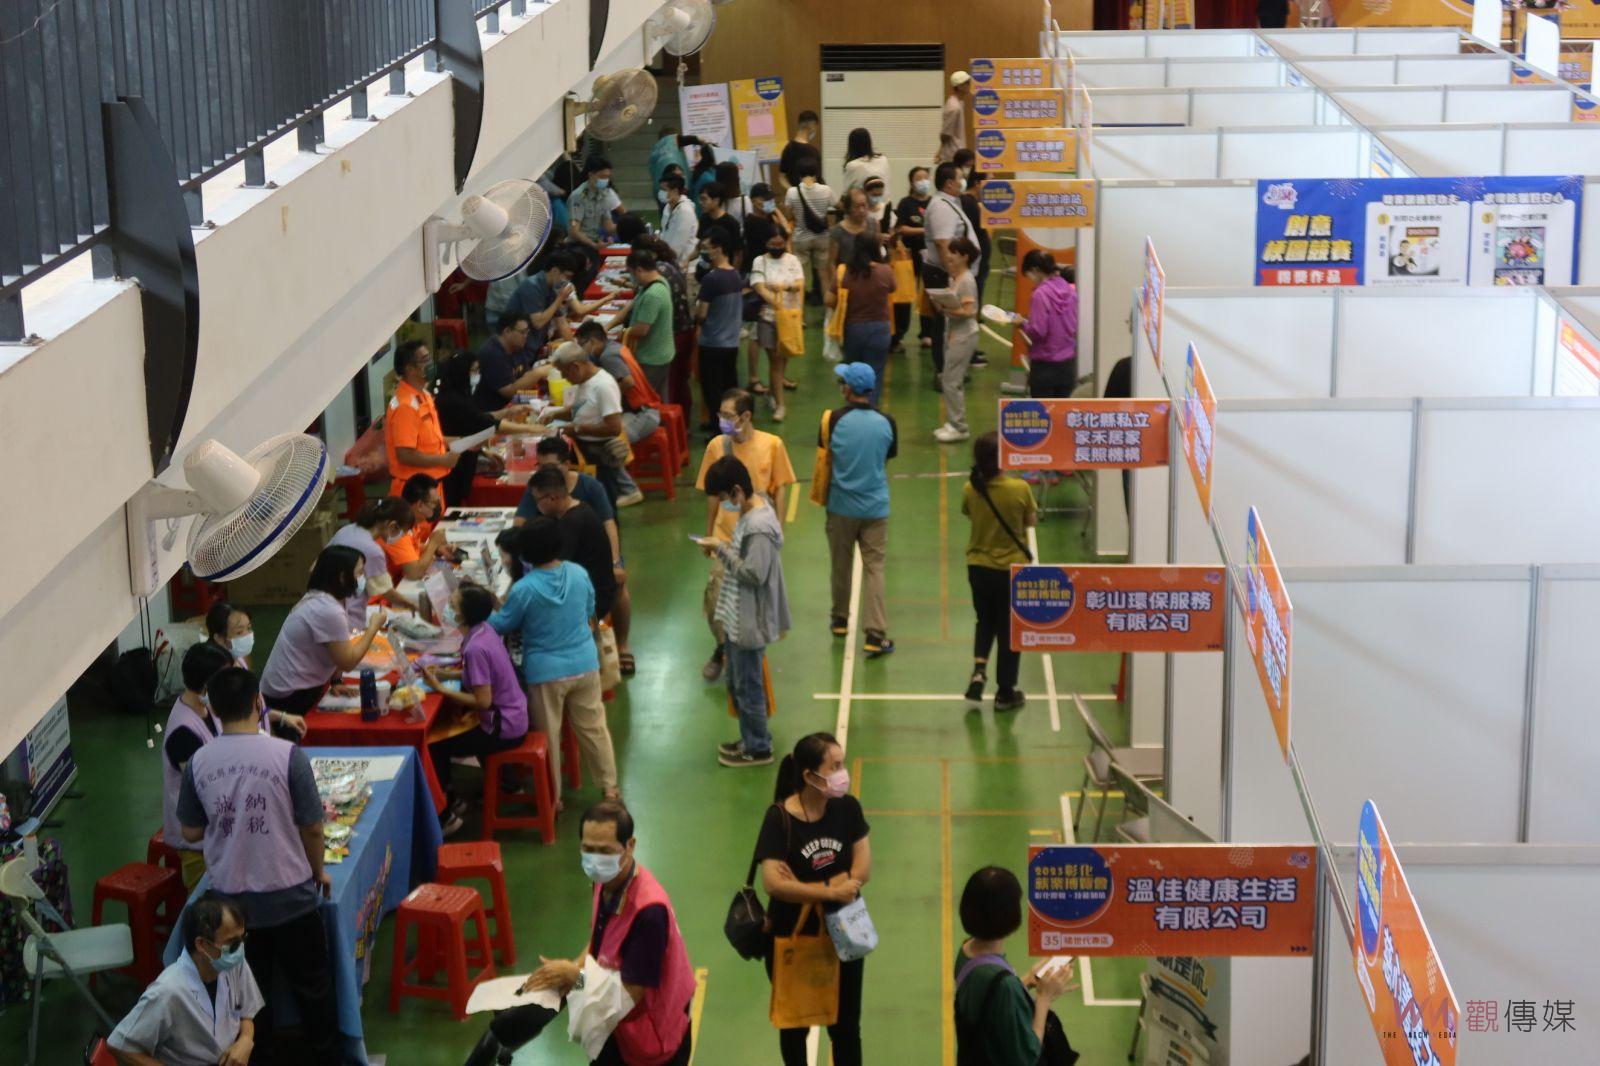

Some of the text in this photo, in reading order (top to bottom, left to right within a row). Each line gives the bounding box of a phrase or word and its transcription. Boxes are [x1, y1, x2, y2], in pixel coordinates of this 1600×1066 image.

[1066, 411, 1151, 429] 彰化縣私立
[1074, 429, 1141, 446] 家禾居家
[1074, 446, 1141, 463] 長照機構
[1085, 589, 1213, 611] 彰山環保服務
[1106, 612, 1191, 632] 有限公司
[800, 838, 820, 859] KEEP
[820, 837, 843, 852] GOING
[1126, 876, 1297, 904] 溫佳健康生活
[1155, 905, 1268, 931] 有限公司
[1043, 936, 1059, 947] 35
